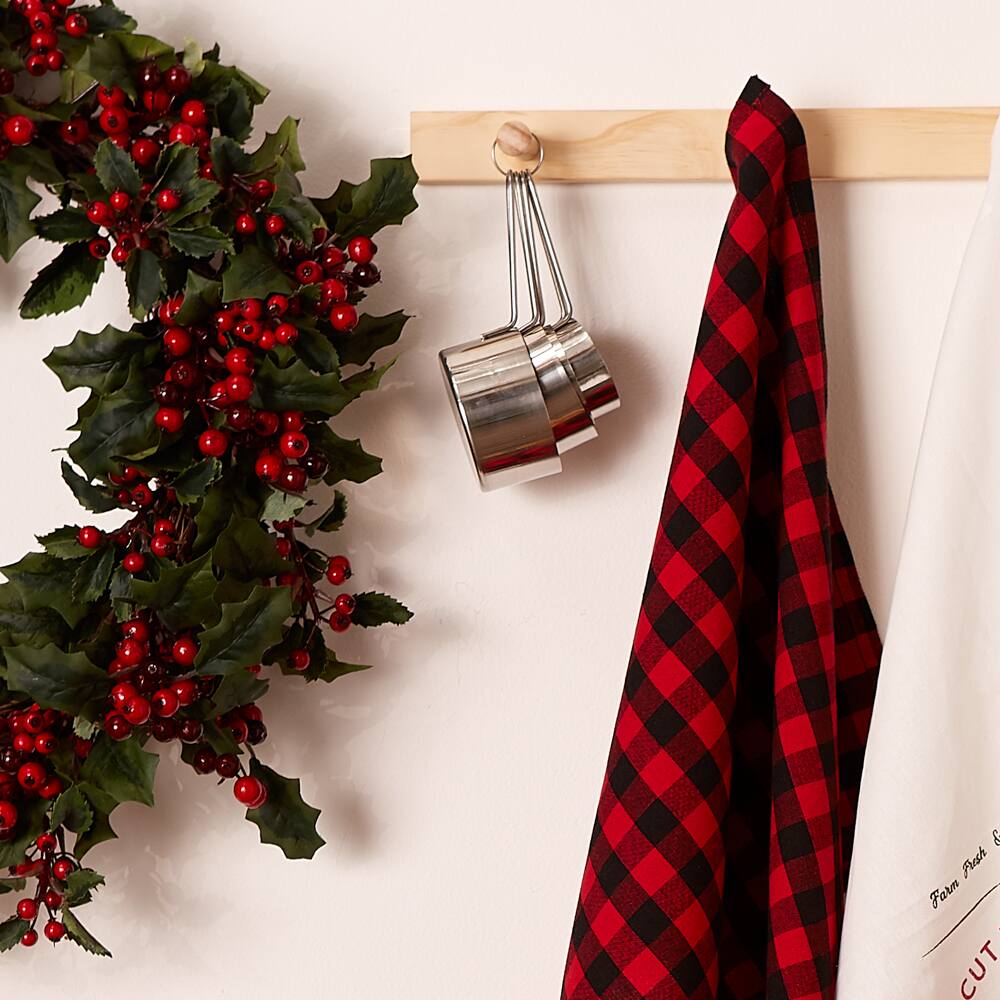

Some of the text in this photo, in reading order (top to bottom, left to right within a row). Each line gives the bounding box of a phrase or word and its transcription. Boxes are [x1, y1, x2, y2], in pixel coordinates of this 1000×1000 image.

[929, 879, 960, 909] Farm
[962, 846, 988, 880] Fresh
[960, 940, 998, 1000] CUT
